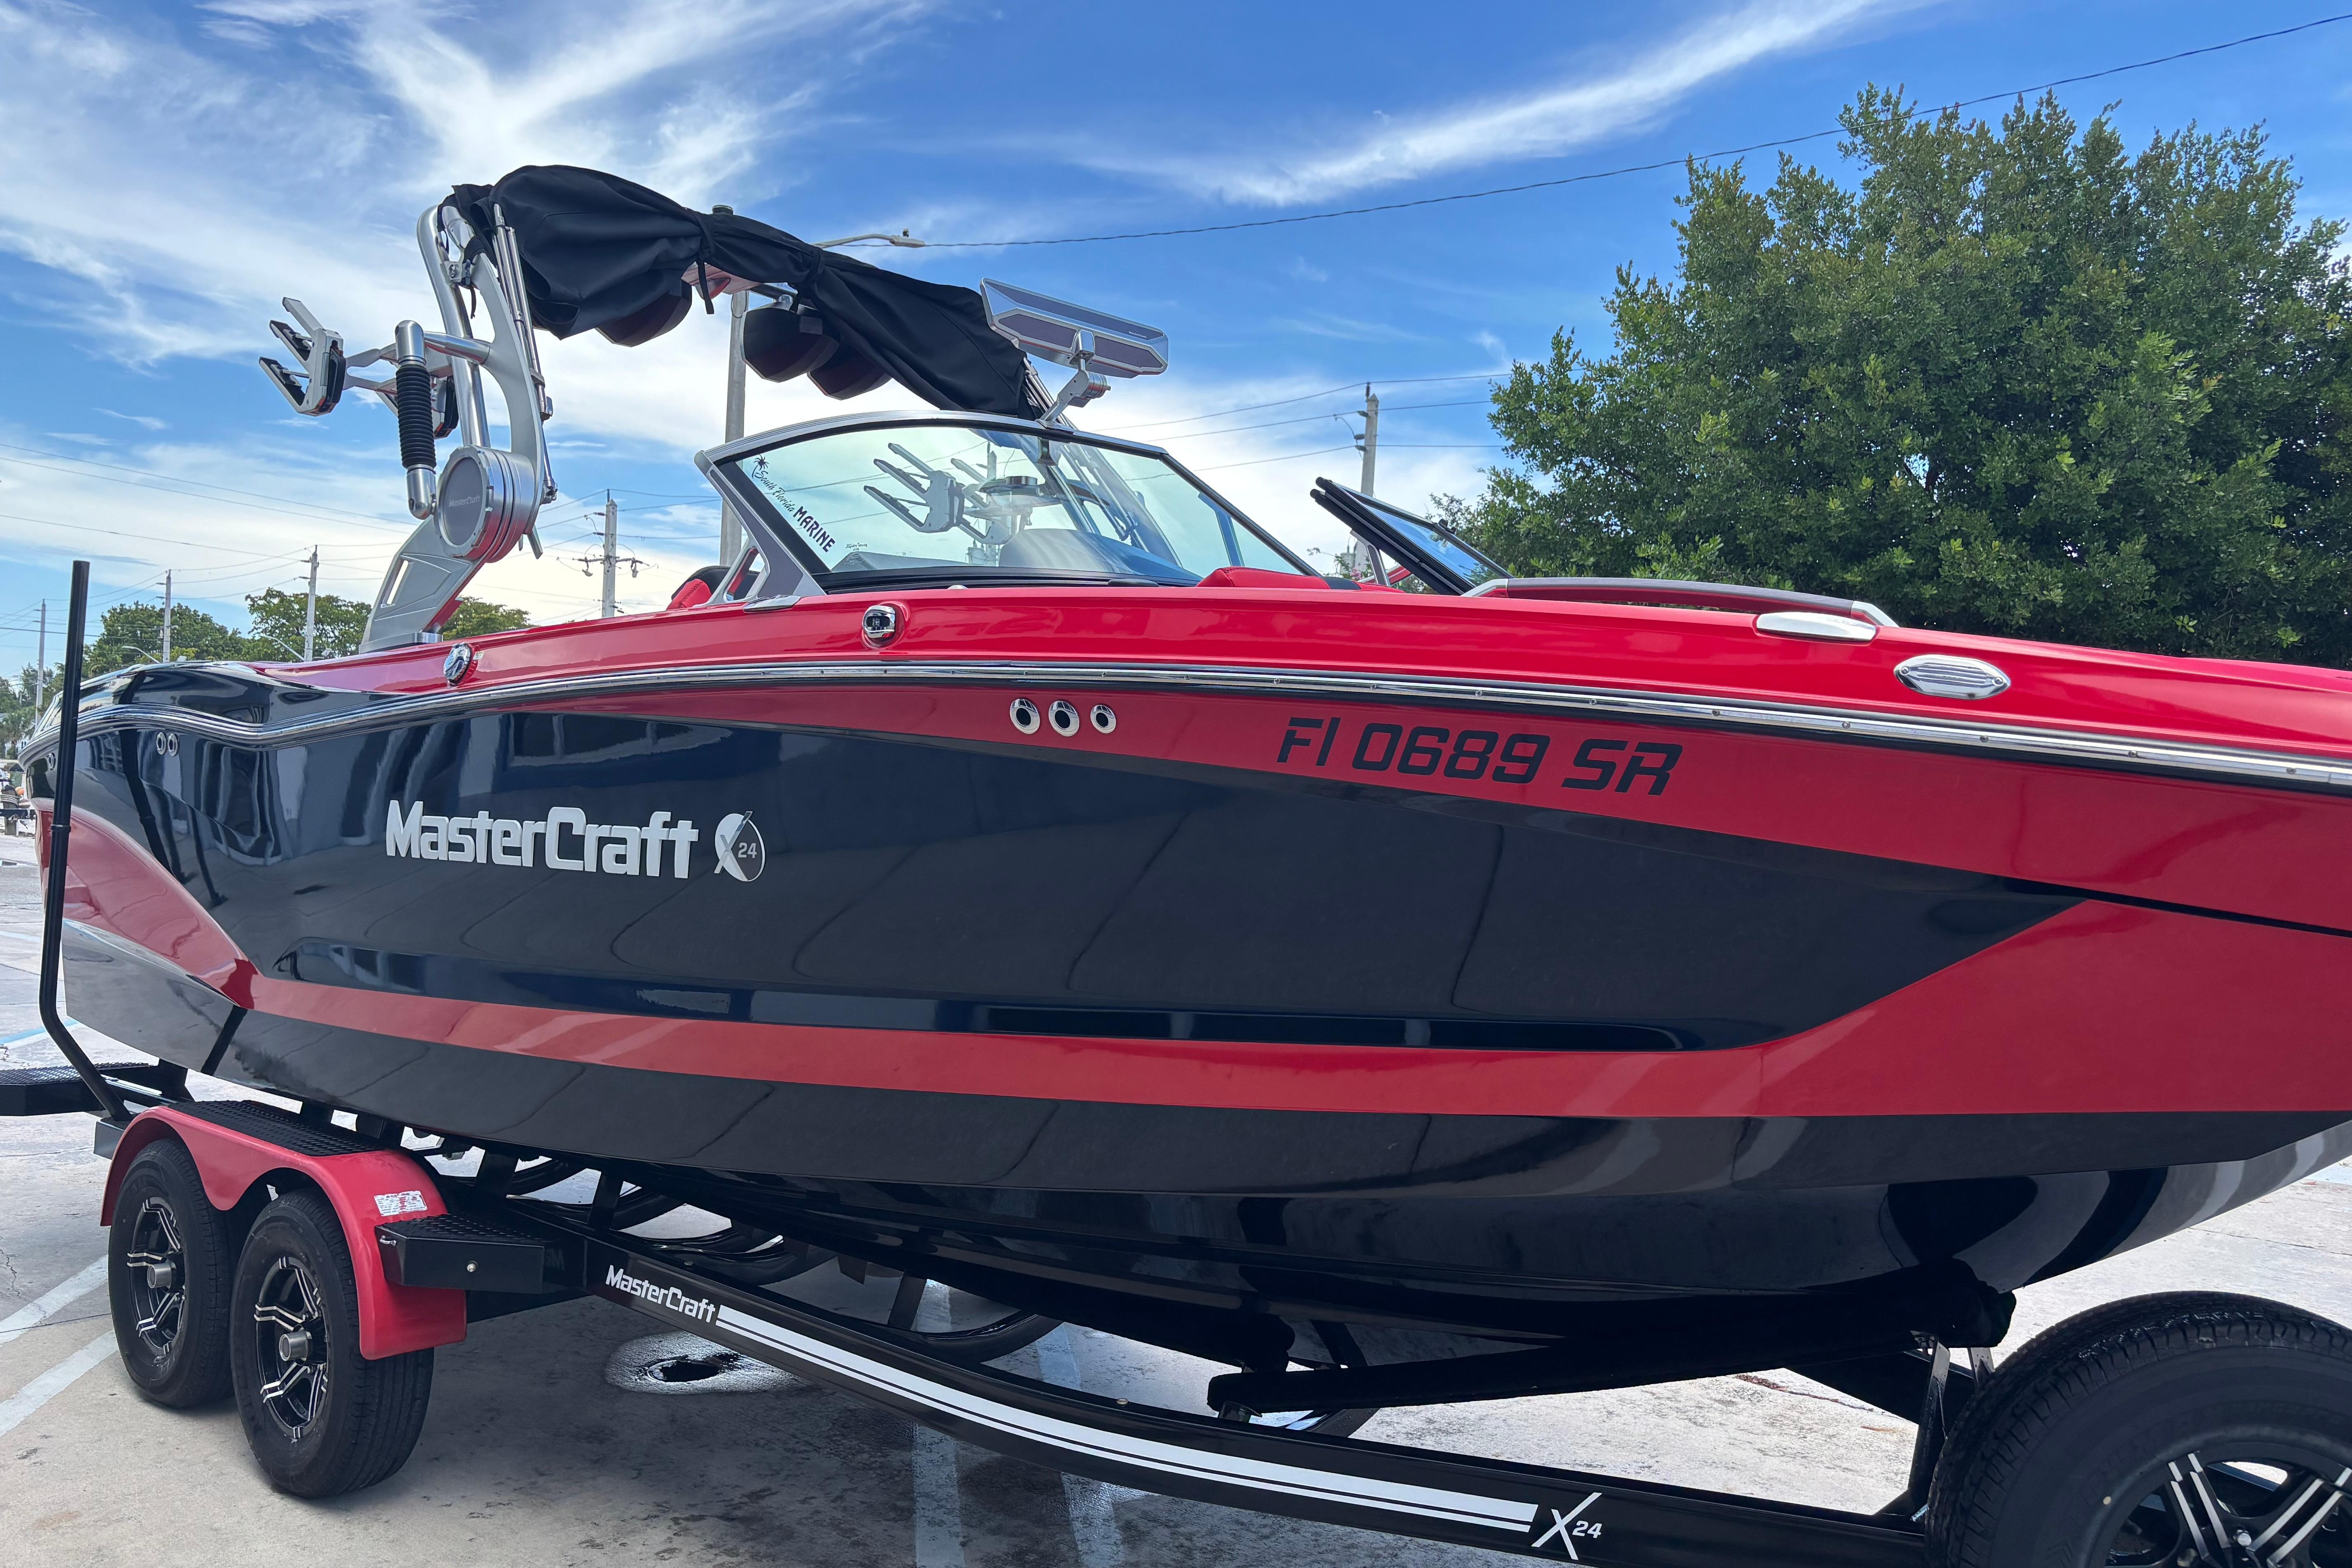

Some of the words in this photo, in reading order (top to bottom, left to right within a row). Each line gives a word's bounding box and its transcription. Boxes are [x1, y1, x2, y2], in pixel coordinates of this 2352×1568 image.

[754, 471, 777, 490] South
[772, 487, 795, 512] Florida
[793, 506, 836, 553] MARINE
[1352, 723, 1550, 784] 0689
[1561, 739, 1683, 796] SR
[386, 800, 699, 878] MasterCraft
[605, 1265, 716, 1323] MasterCraft
